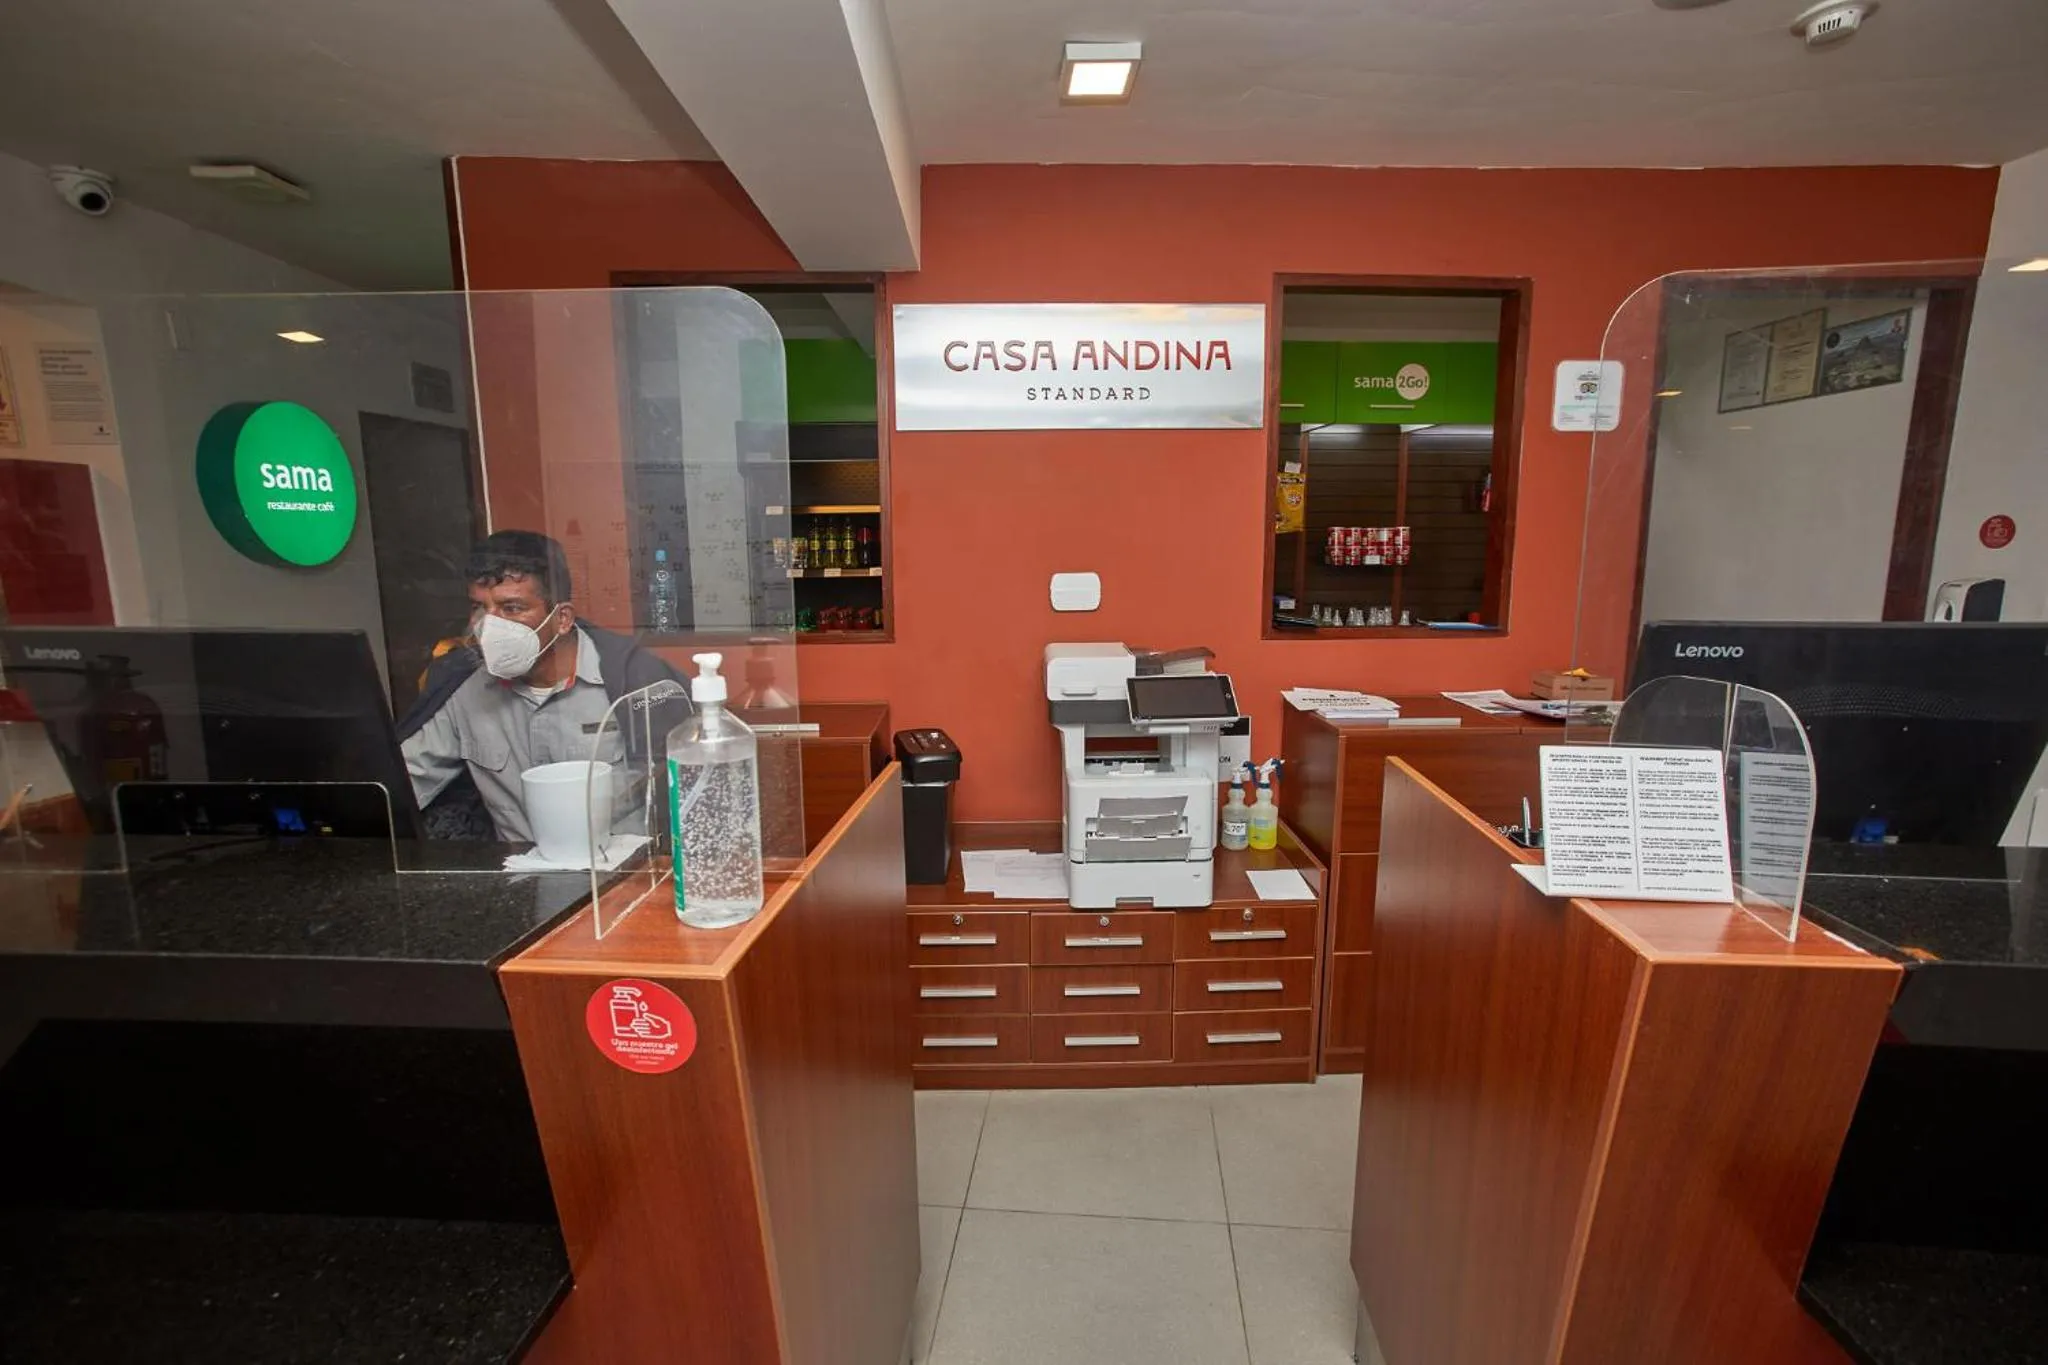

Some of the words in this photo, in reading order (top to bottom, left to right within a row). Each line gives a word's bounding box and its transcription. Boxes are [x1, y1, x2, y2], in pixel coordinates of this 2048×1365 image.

[944, 340, 1058, 372] CASA
[1073, 340, 1232, 372] ANDINA
[1354, 376, 1395, 389] sama
[1398, 375, 1428, 389] 2Go!
[1027, 387, 1151, 401] STANDARD
[260, 463, 333, 492] sama
[267, 501, 316, 511] restaurante
[23, 645, 80, 660] Lenovo
[1675, 642, 1744, 658] Lenovo
